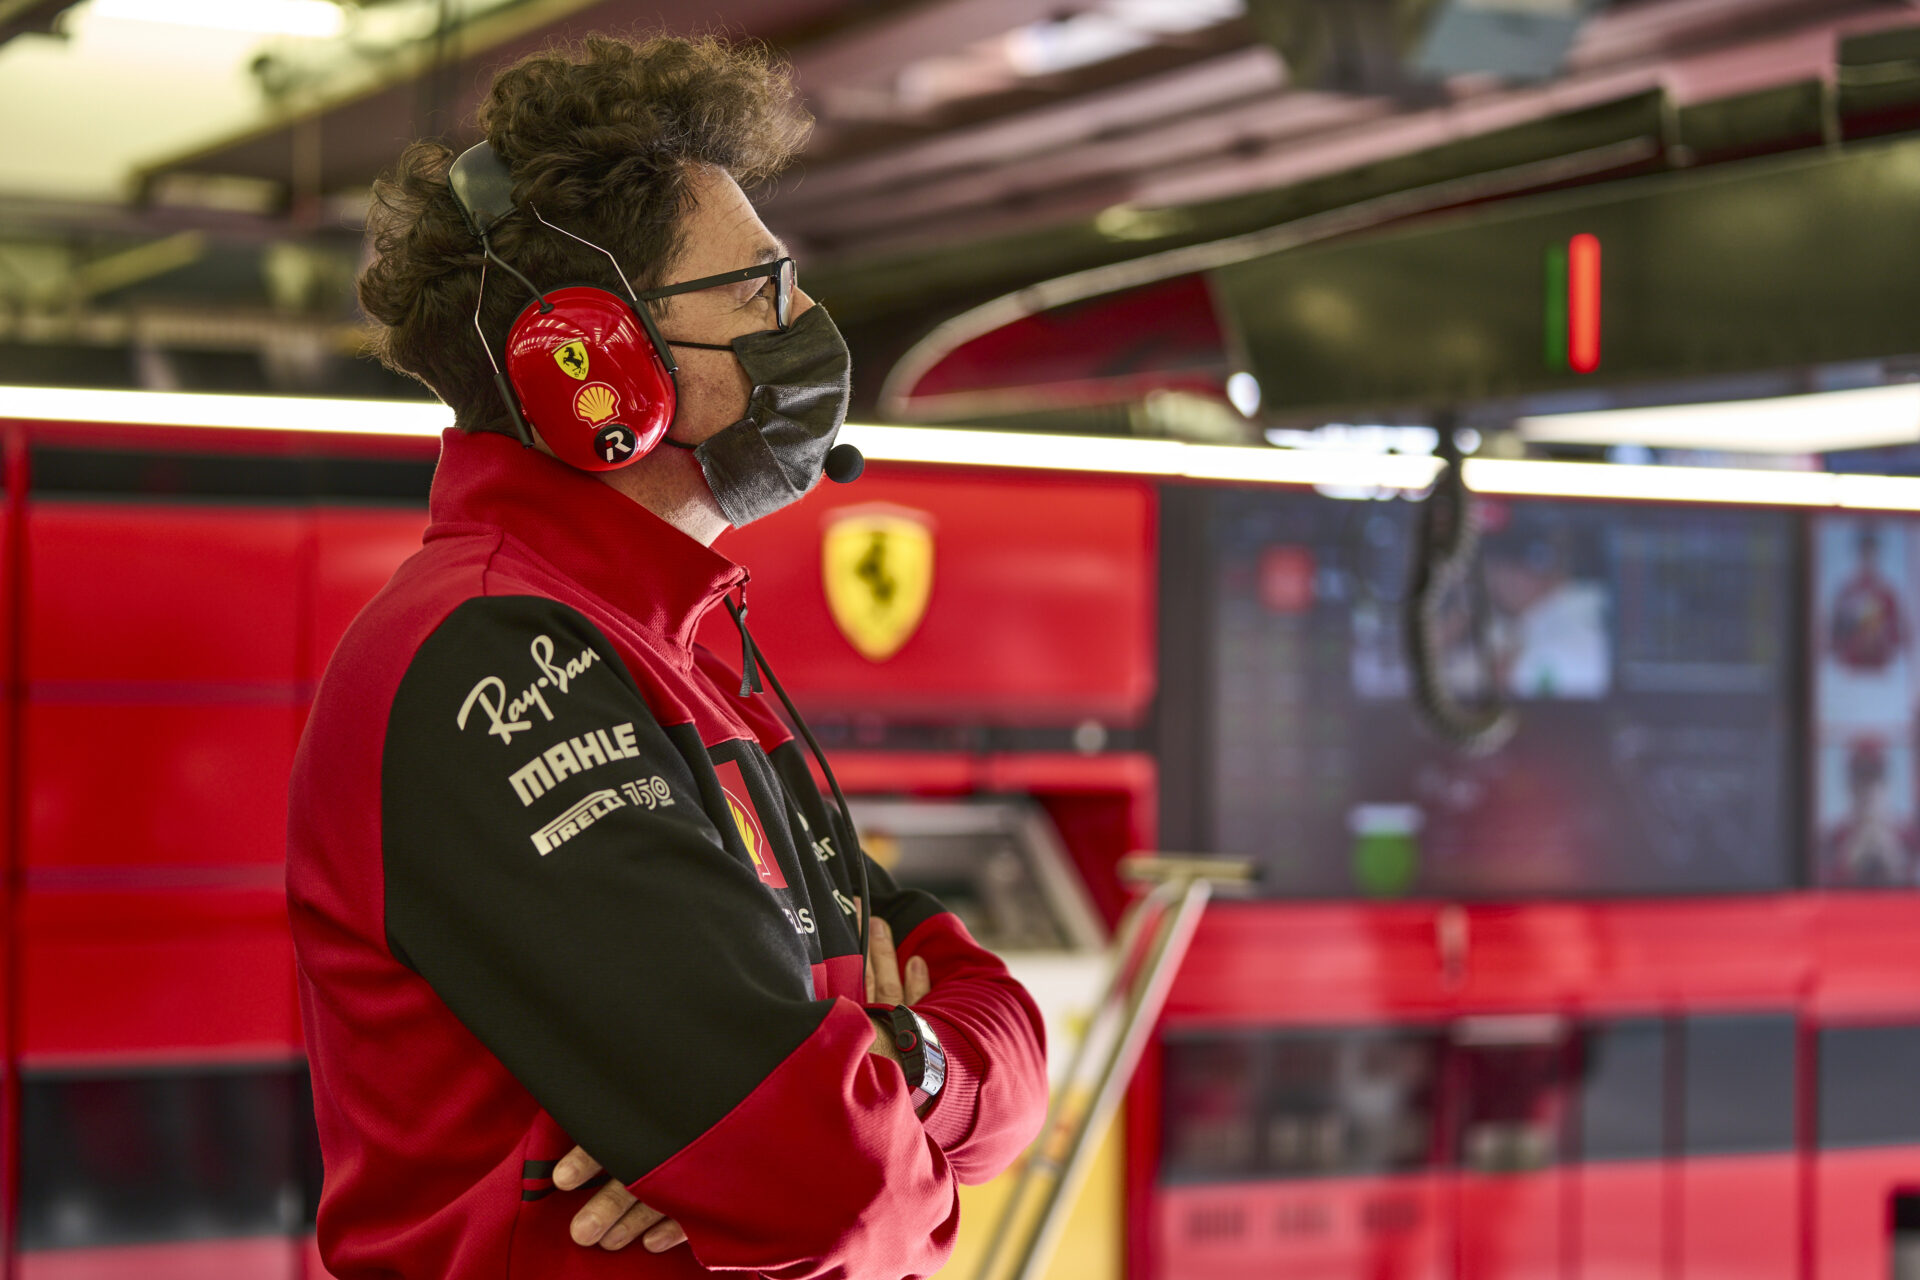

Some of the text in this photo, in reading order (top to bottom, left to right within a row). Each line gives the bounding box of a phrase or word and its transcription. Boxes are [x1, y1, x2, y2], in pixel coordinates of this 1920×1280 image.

[508, 722, 640, 807] MAHLE
[530, 775, 671, 856] PIRELLI 150
